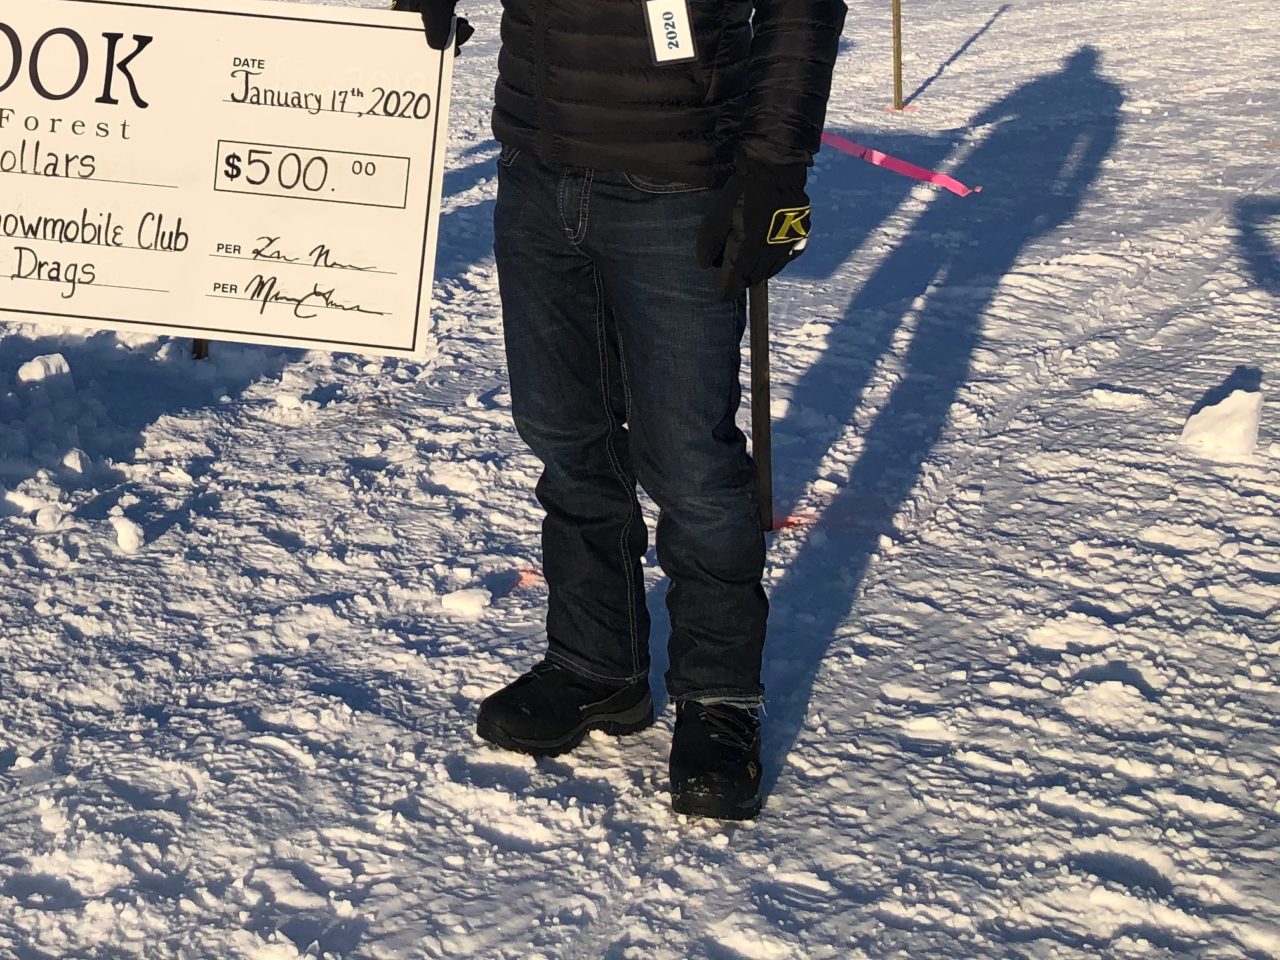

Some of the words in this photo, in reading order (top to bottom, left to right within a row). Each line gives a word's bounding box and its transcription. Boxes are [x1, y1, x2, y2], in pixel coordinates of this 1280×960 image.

[662, 11, 680, 50] 2020
[233, 57, 265, 69] DATE
[230, 70, 322, 115] January
[352, 160, 376, 176] 00
[137, 212, 189, 252] Club
[216, 243, 241, 255] PER
[10, 246, 97, 299] Drags
[213, 283, 238, 294] PER
